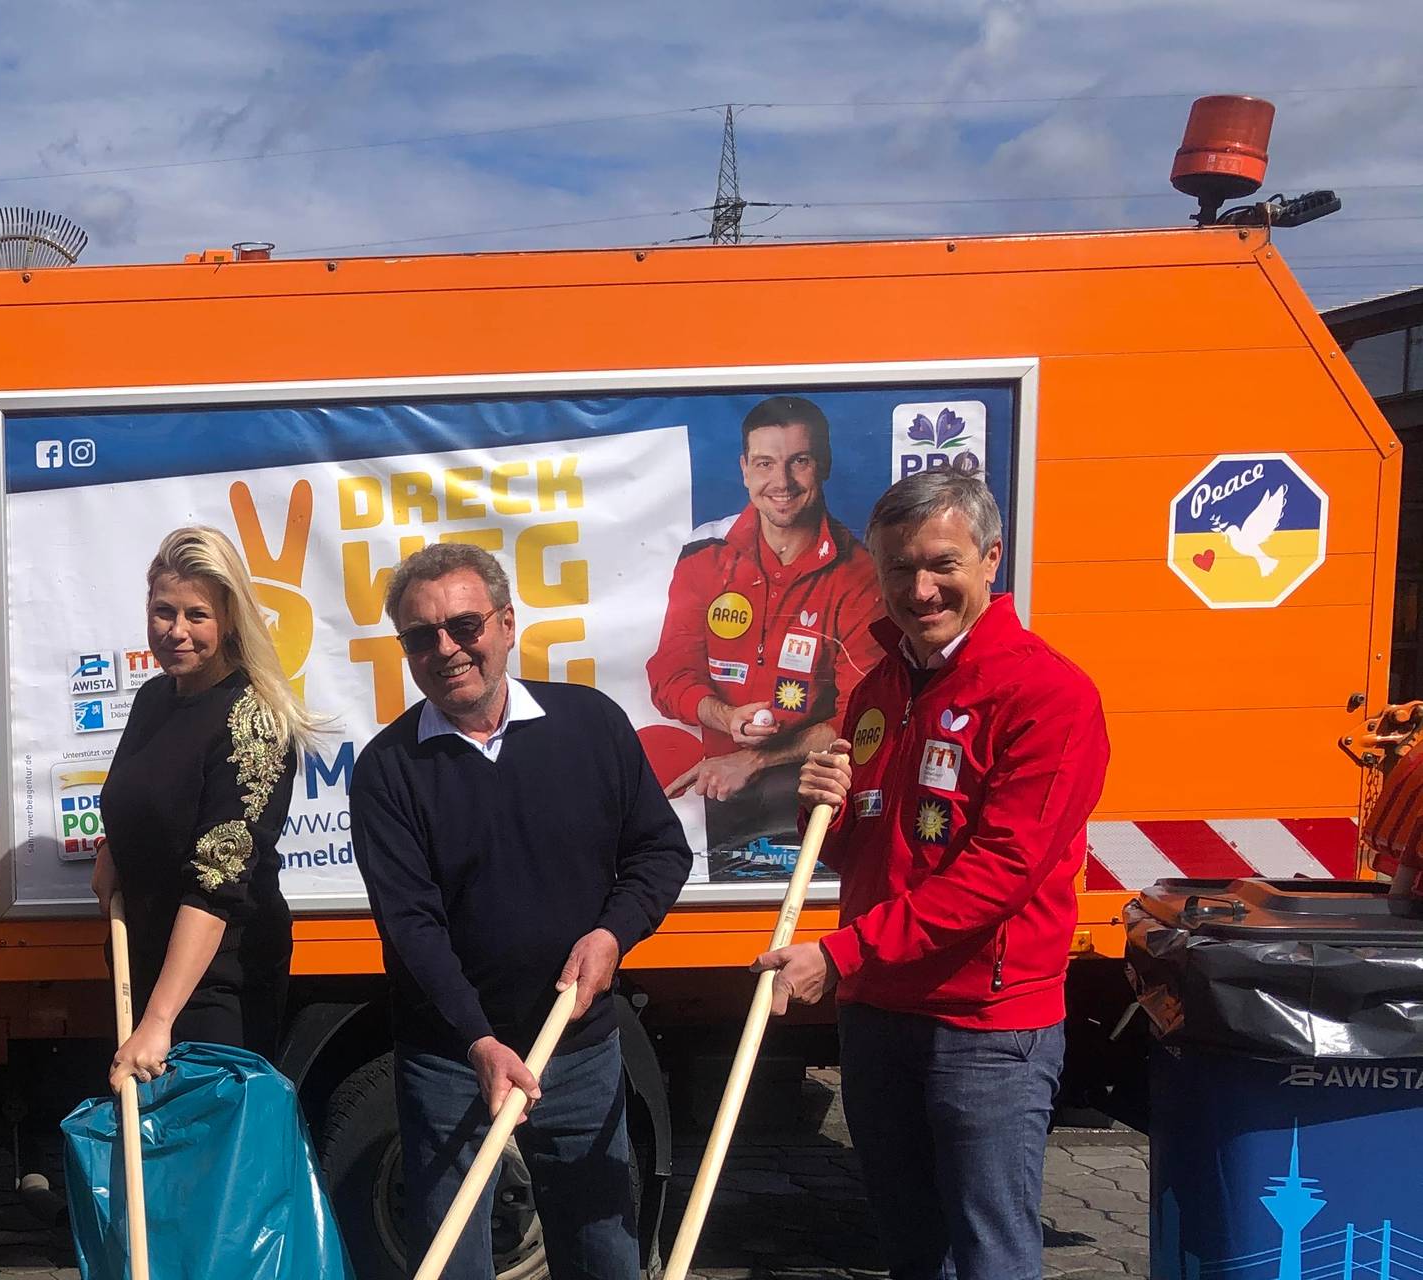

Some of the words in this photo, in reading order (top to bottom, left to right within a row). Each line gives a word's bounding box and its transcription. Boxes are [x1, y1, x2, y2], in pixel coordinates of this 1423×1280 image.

[337, 456, 584, 530] DRECK
[1190, 463, 1265, 519] Peace
[342, 521, 589, 626] WG
[712, 607, 748, 625] ARAG
[349, 618, 595, 724] TG
[72, 679, 114, 692] AWISTA
[110, 701, 132, 710] Lande
[855, 727, 881, 747] ARAG
[62, 751, 100, 760] Unterstützt
